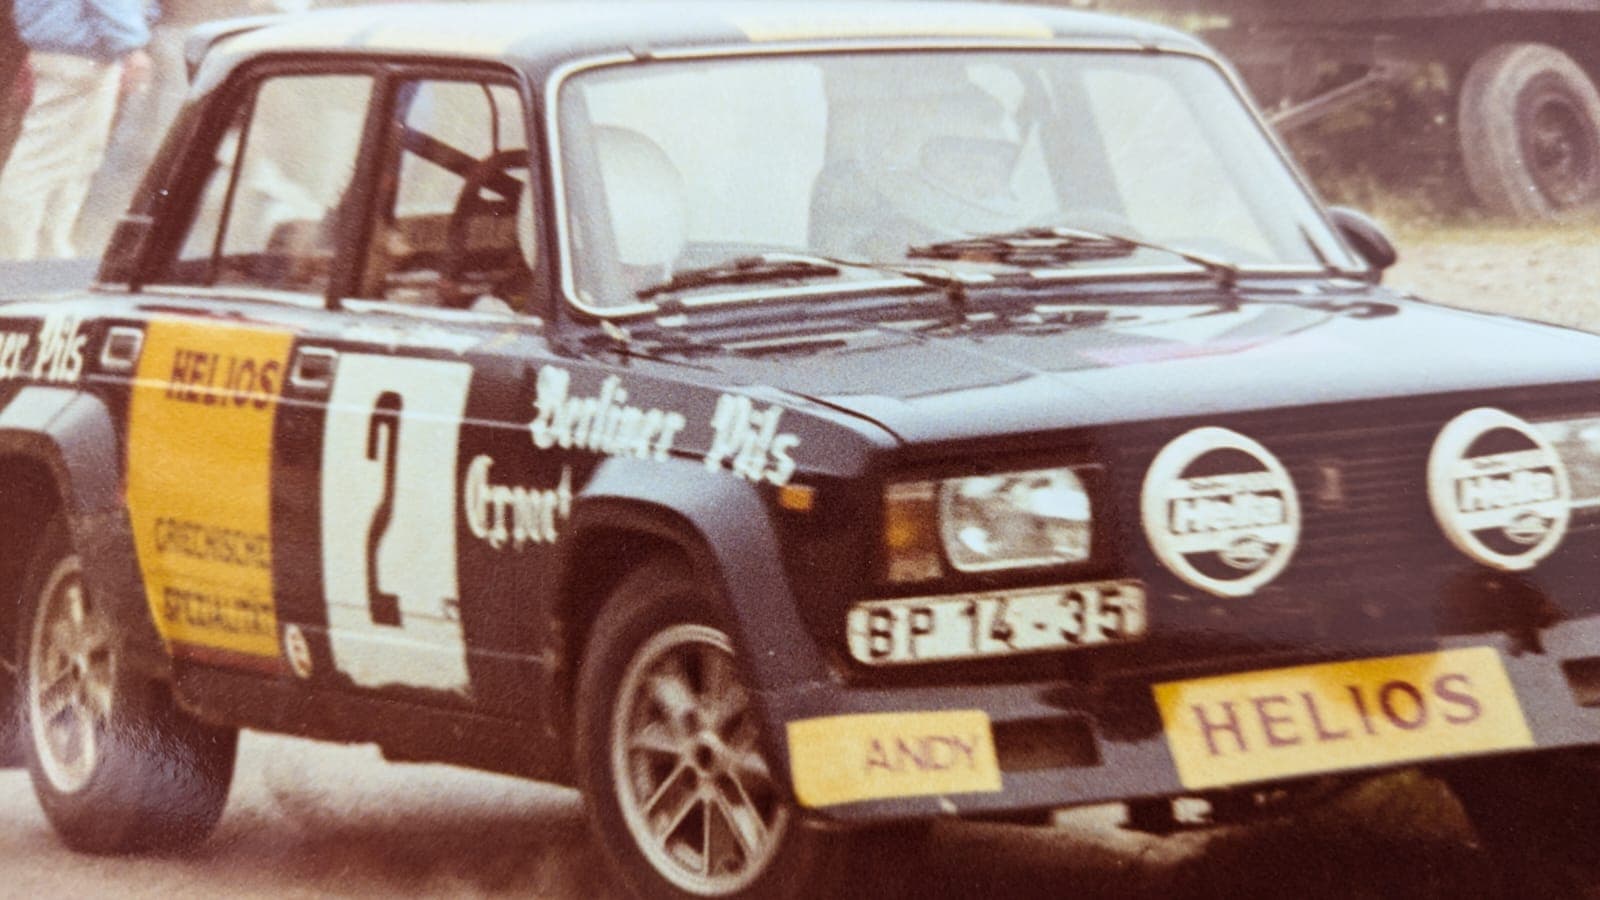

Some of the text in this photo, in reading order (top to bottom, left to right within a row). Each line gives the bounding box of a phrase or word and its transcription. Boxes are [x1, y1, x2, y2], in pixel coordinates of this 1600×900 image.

[165, 346, 281, 410] HELIOS
[530, 364, 800, 486] Berliner Pils
[366, 390, 404, 628] 2
[867, 606, 933, 660] BP
[1192, 673, 1483, 757] HELIOS
[866, 734, 978, 772] ANDY
